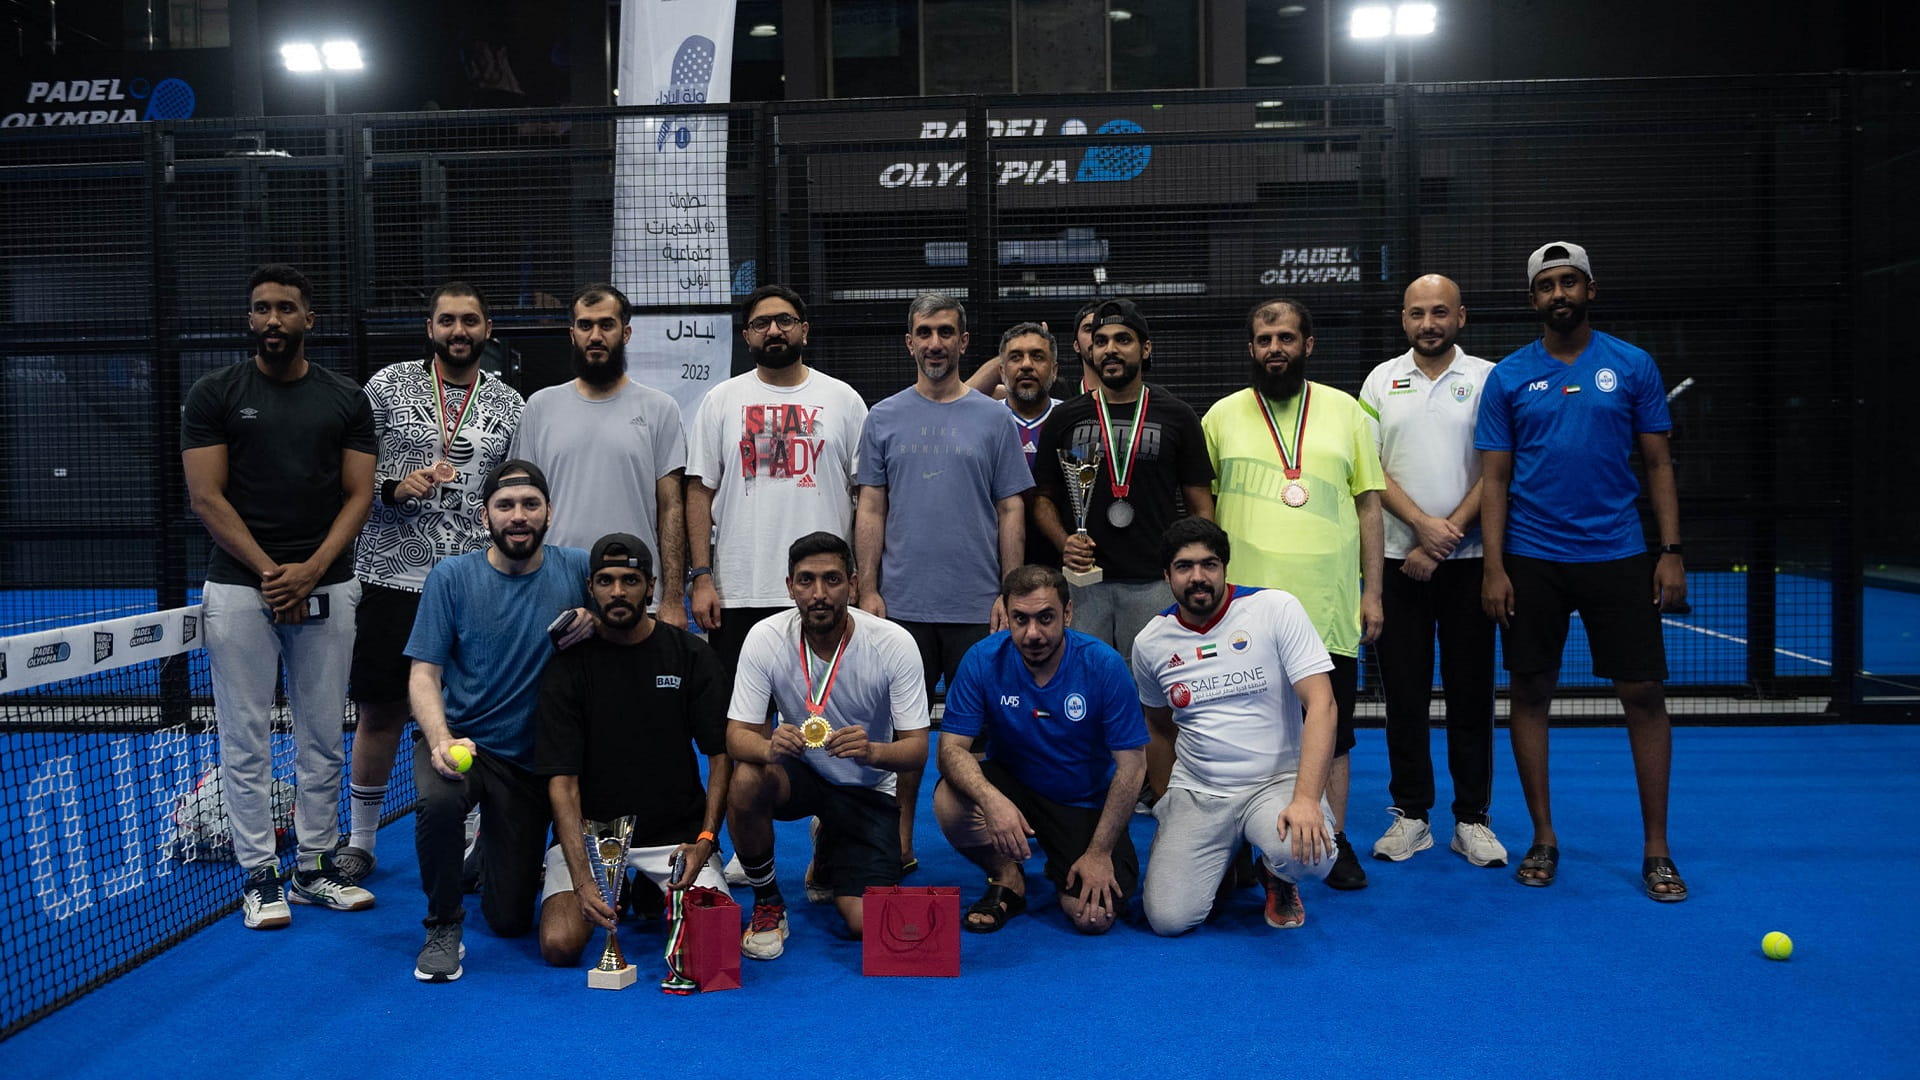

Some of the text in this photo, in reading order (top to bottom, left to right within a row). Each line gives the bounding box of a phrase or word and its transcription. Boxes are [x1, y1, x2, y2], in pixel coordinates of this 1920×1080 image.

[27, 79, 125, 103] PADEL
[879, 160, 1070, 188] OLYPIA
[1279, 248, 1351, 266] PADEL
[1260, 266, 1360, 285] OLYMPIA
[681, 363, 710, 381] 2023
[746, 405, 818, 436] STAY
[921, 426, 960, 437] NIKE
[900, 443, 975, 456] RUNNING
[1230, 460, 1311, 501] PUM
[28, 654, 57, 668] OLYMPIA
[33, 646, 55, 658] PADEL
[1191, 666, 1265, 693] SAIF ZONE
